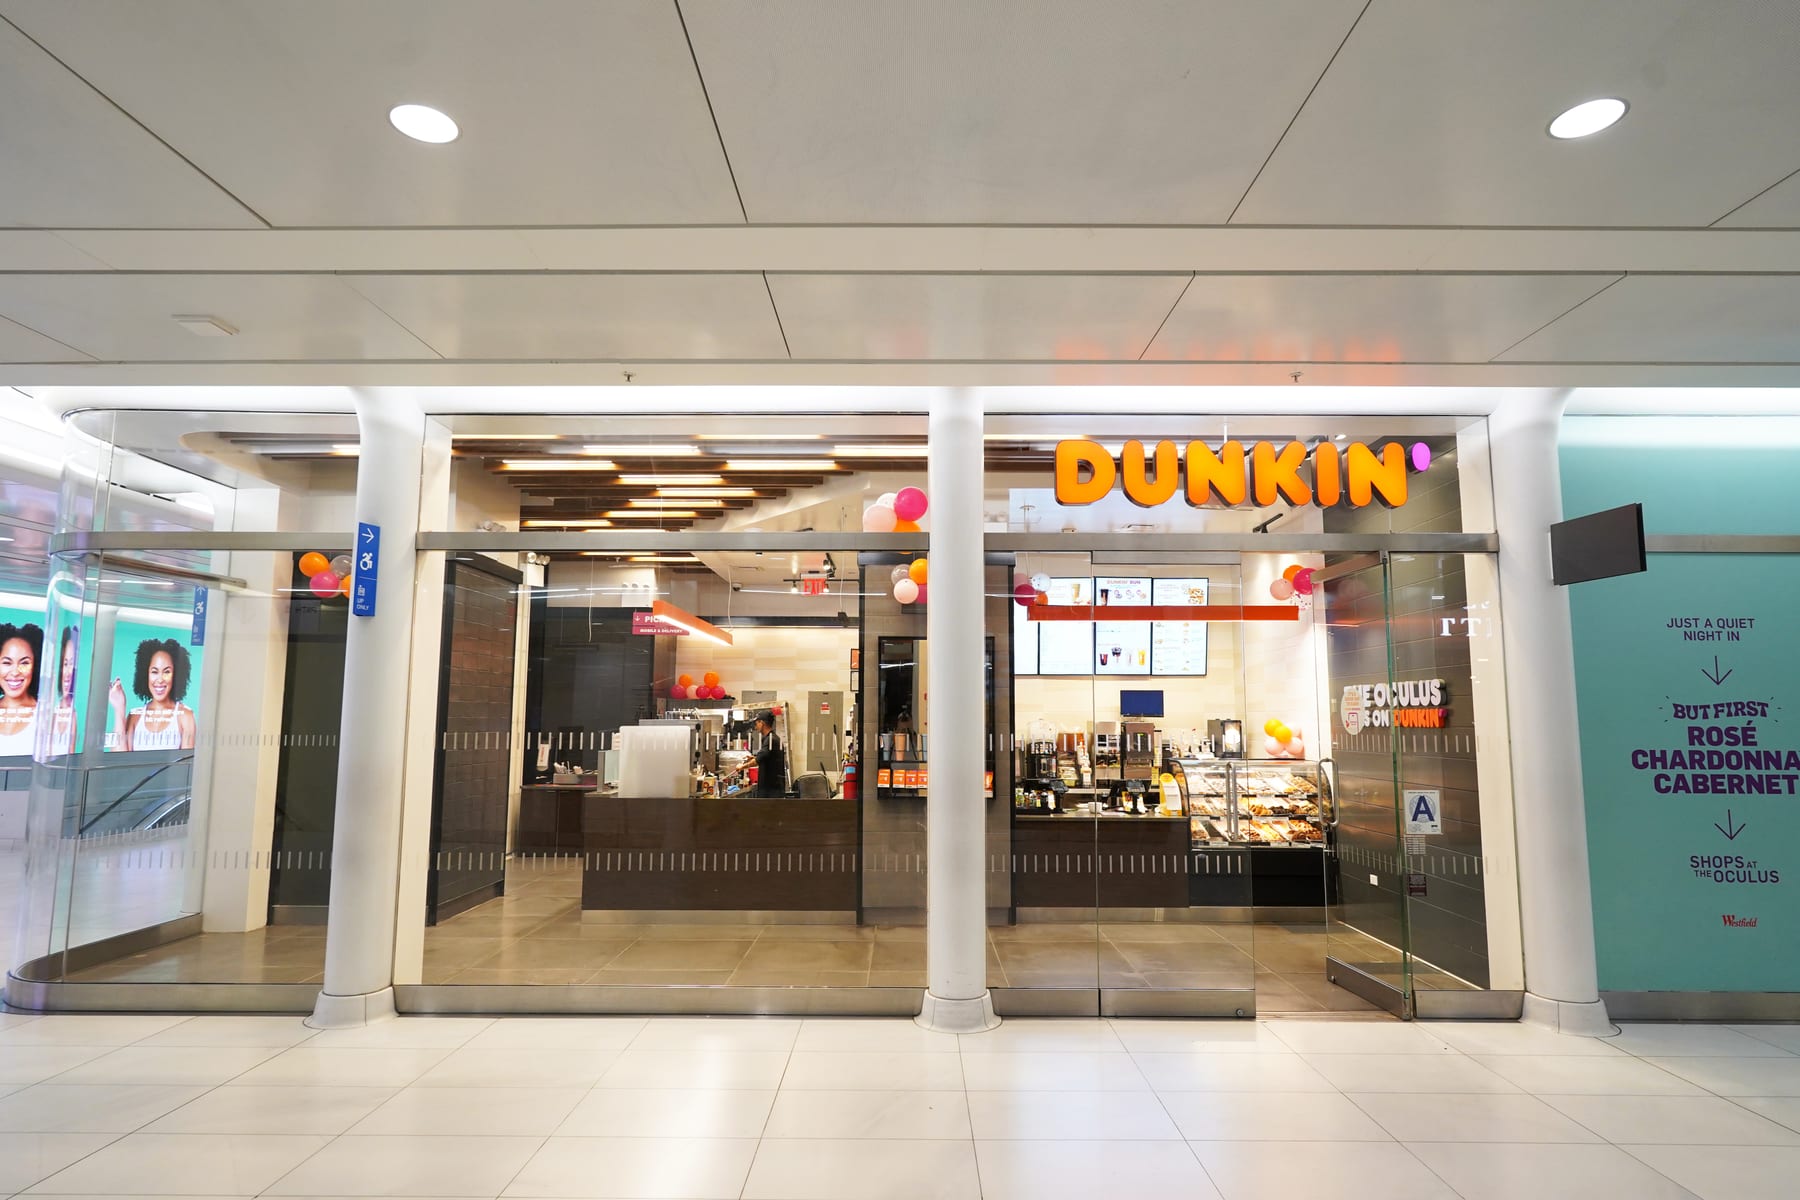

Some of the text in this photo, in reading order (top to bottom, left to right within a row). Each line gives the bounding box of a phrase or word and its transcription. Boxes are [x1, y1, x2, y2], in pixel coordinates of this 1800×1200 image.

[1054, 440, 1430, 508] DUNKIN'
[1666, 617, 1755, 629] JUST A QUIET
[1683, 630, 1741, 641] NIGHT IN
[1373, 679, 1442, 708] OCULUS
[1372, 709, 1389, 727] ON
[1394, 708, 1446, 728] DUNKIN'
[1672, 700, 1769, 720] BUT FIRST
[1687, 720, 1757, 746] ROSÉ
[1631, 749, 1800, 770] CHARDONNA
[1654, 773, 1799, 794] CABERNET
[1411, 795, 1435, 821] A
[1690, 855, 1744, 868] SHOPS
[1694, 870, 1780, 883] THE OCULUS
[1722, 914, 1758, 928] Westfield
